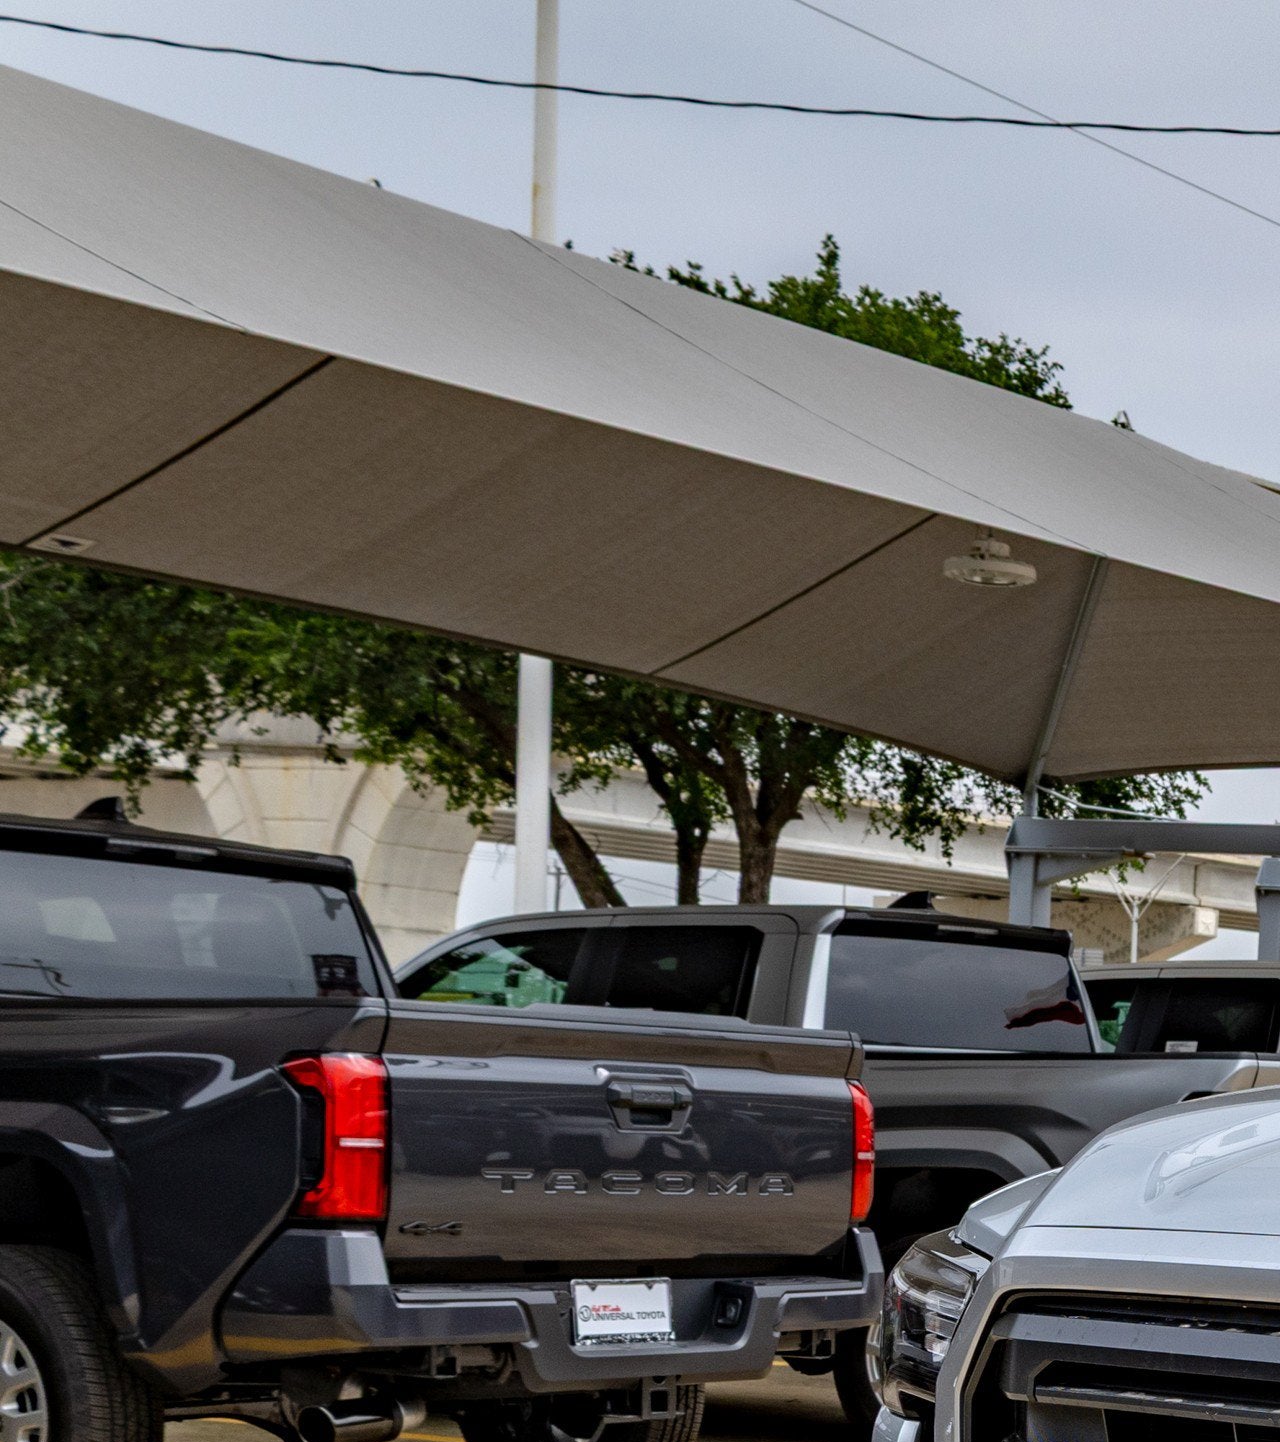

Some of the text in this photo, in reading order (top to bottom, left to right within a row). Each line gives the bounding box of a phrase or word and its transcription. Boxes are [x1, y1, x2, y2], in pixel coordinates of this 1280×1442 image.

[481, 1167, 795, 1196] TACOMA
[592, 1311, 666, 1321] UNIVERSAL TOYOTA
